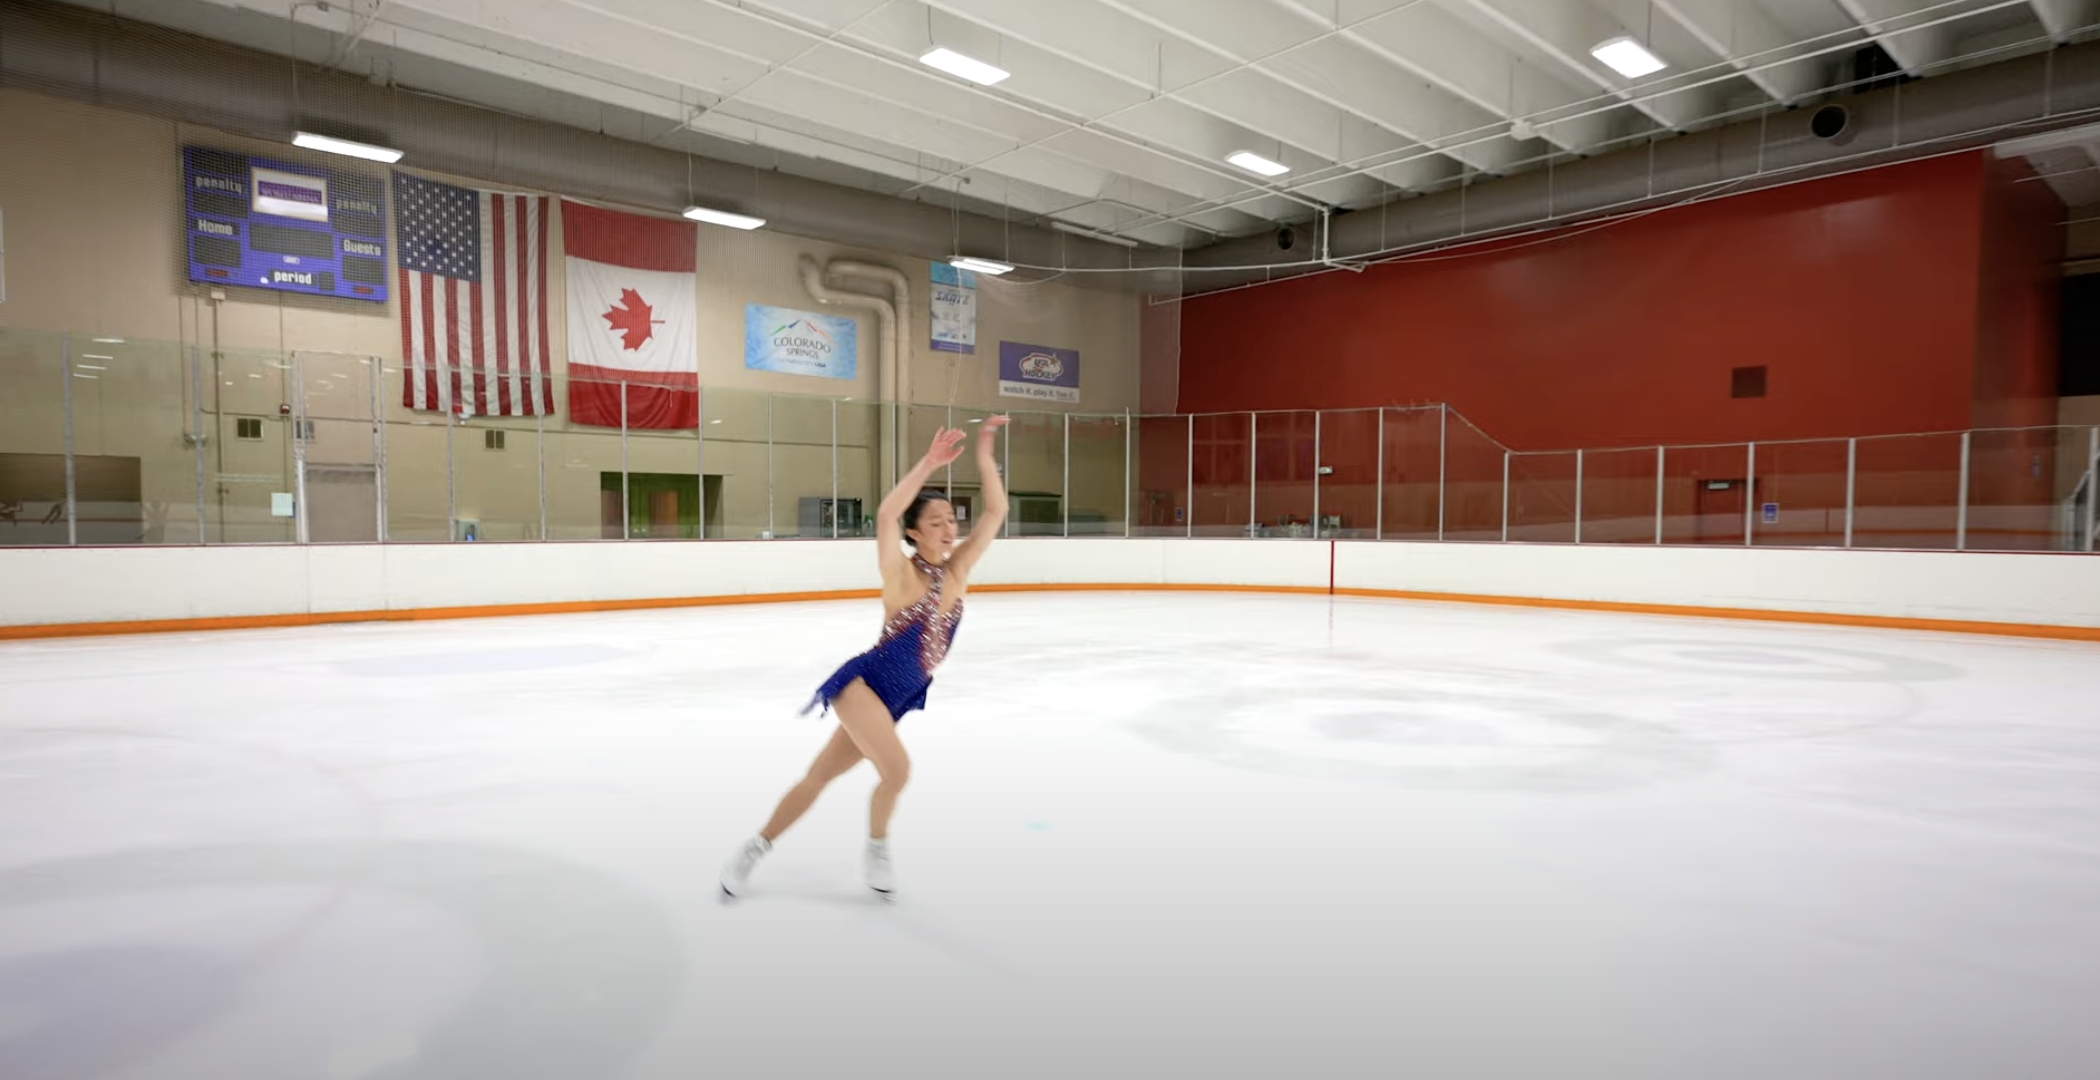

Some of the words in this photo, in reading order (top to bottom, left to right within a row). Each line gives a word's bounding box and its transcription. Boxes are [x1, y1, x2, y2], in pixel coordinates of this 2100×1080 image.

[195, 175, 242, 193] penalty
[335, 199, 378, 214] penalty
[198, 219, 233, 236] Home
[343, 239, 381, 256] Guests
[273, 270, 312, 285] period
[774, 336, 831, 353] COLORADO
[786, 347, 819, 359] SPRINGS
[1025, 368, 1056, 379] HOCKEY
[1003, 386, 1024, 394] watch
[1033, 388, 1048, 397] play
